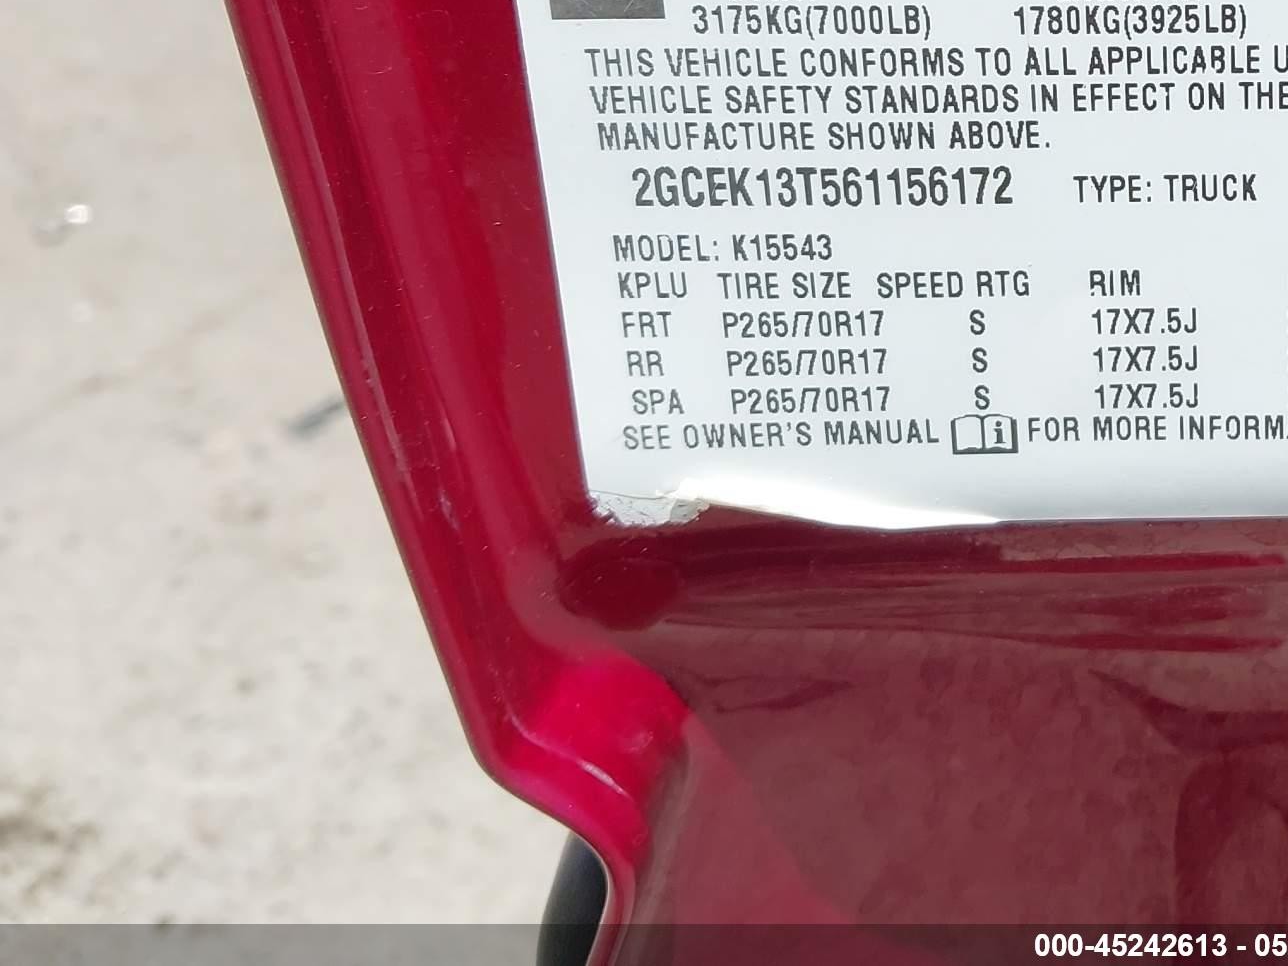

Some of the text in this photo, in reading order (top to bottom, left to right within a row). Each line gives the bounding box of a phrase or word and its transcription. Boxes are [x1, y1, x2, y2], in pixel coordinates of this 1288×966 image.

[692, 5, 930, 40] 3175KG(7000LB)
[1014, 4, 1246, 40] 1780KG(3925LB)
[584, 49, 654, 76] THIS
[664, 48, 787, 77] VEHICLE
[800, 48, 964, 77] CONFORMS
[975, 48, 1011, 76] TO
[1025, 46, 1076, 76] ALL
[1088, 45, 1260, 75] APPLICABLE
[590, 85, 712, 114] VEHICLE
[725, 85, 832, 113] SAFETY
[845, 84, 1018, 114] STANDARDS
[1031, 84, 1058, 112] IN
[1073, 83, 1175, 111] EFFECT
[1188, 82, 1224, 110] ON
[598, 121, 1049, 150] MANUFACTURE SHOWN ABOVE.
[632, 166, 1013, 207] 2GCEK13T561156172
[1073, 174, 1256, 203] TYPE: TRUCK
[613, 234, 832, 261] MODEL: K15543
[618, 272, 687, 298] KPLU
[717, 272, 851, 299] TIRE SIZE
[877, 270, 1029, 298] SPEED RTG
[1090, 270, 1140, 296] RIM
[622, 312, 671, 337] FRT
[723, 310, 883, 338] P265/70R17
[970, 310, 985, 335] S
[1092, 308, 1196, 334] 17X7.5J
[627, 351, 664, 376] RR
[727, 349, 886, 376] P265/70R17
[972, 348, 987, 373] S
[1093, 346, 1197, 372] 17X7.5J
[632, 389, 684, 414] SPA
[731, 386, 889, 414] P265/70R17
[975, 385, 990, 410] S
[1095, 383, 1198, 409] 17X7.5J
[624, 425, 670, 449] SEE
[684, 422, 811, 448] OWNER'S
[824, 419, 939, 445] MANUAL
[1028, 417, 1080, 442] FOR
[1093, 416, 1166, 441] MORE
